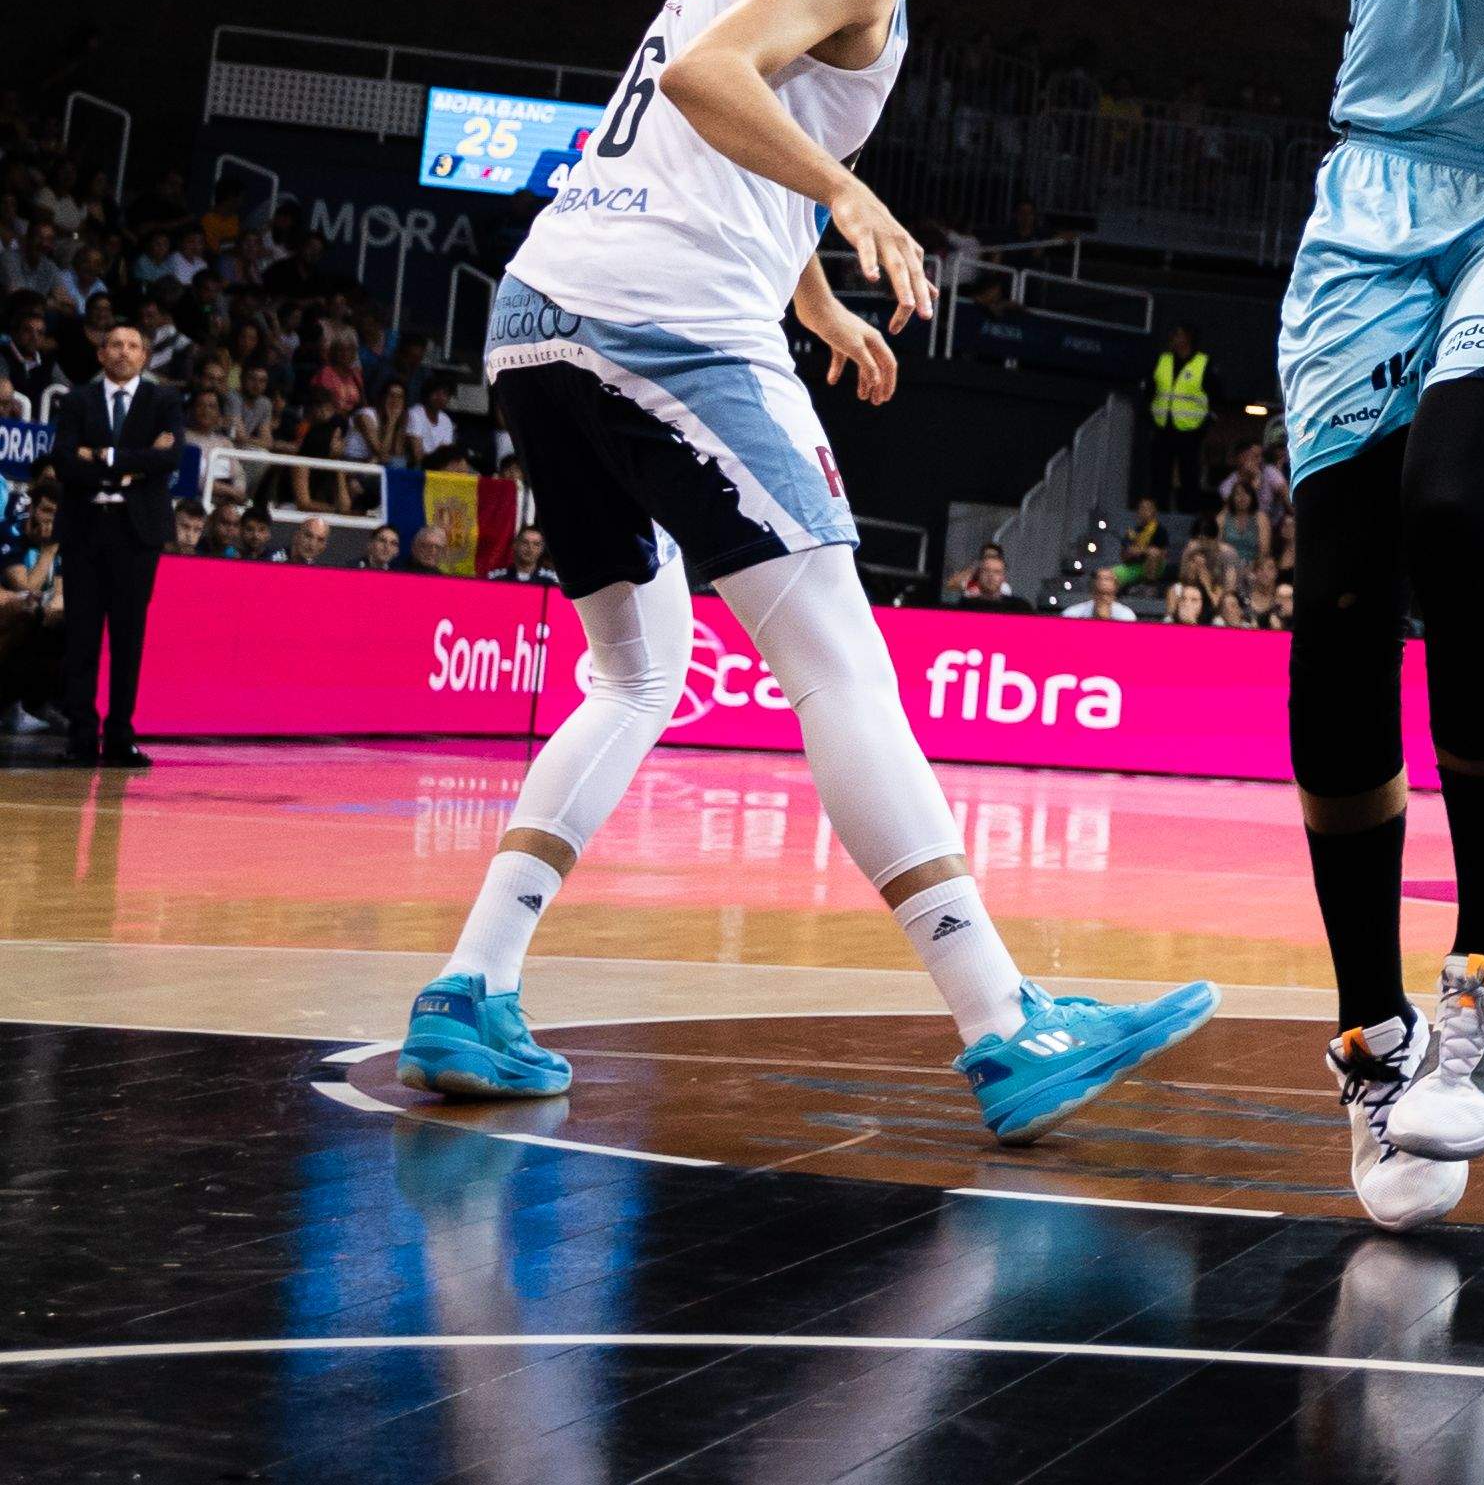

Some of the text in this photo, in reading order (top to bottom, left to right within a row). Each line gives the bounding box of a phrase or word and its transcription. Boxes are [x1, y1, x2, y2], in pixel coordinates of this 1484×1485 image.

[455, 116, 523, 159] 25
[1329, 405, 1383, 429] Ando
[427, 617, 551, 693] Som-hi
[927, 648, 1123, 729] fibra
